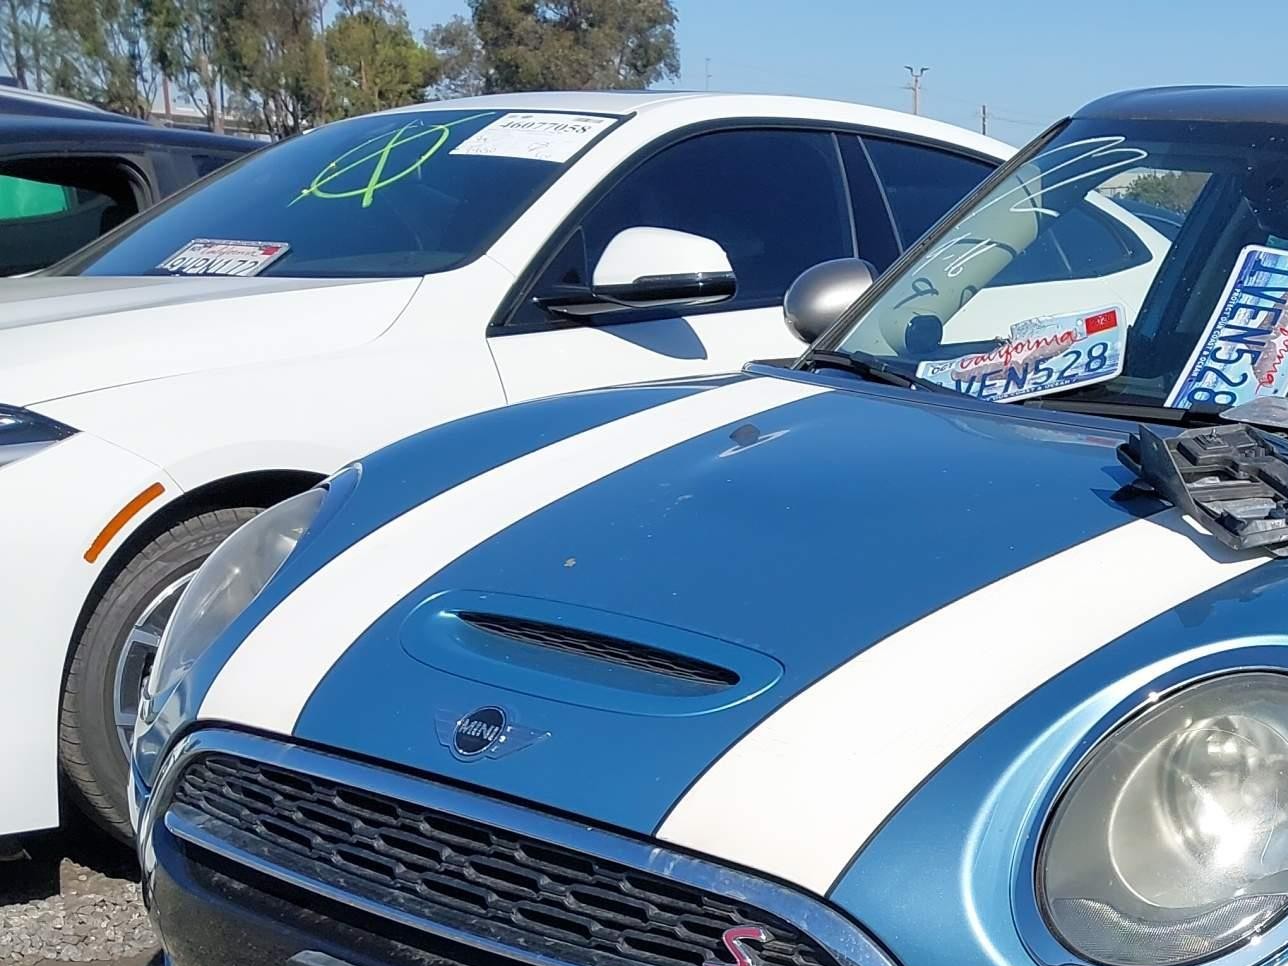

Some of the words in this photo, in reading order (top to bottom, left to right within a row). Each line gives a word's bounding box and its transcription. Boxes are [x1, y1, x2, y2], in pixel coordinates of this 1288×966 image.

[1223, 288, 1241, 316] PROTECT
[1215, 316, 1228, 331] OUR
[1205, 329, 1221, 353] COAST
[937, 341, 1110, 400] VEN528
[1191, 356, 1206, 377] OCEAN
[458, 718, 500, 741] MINI
